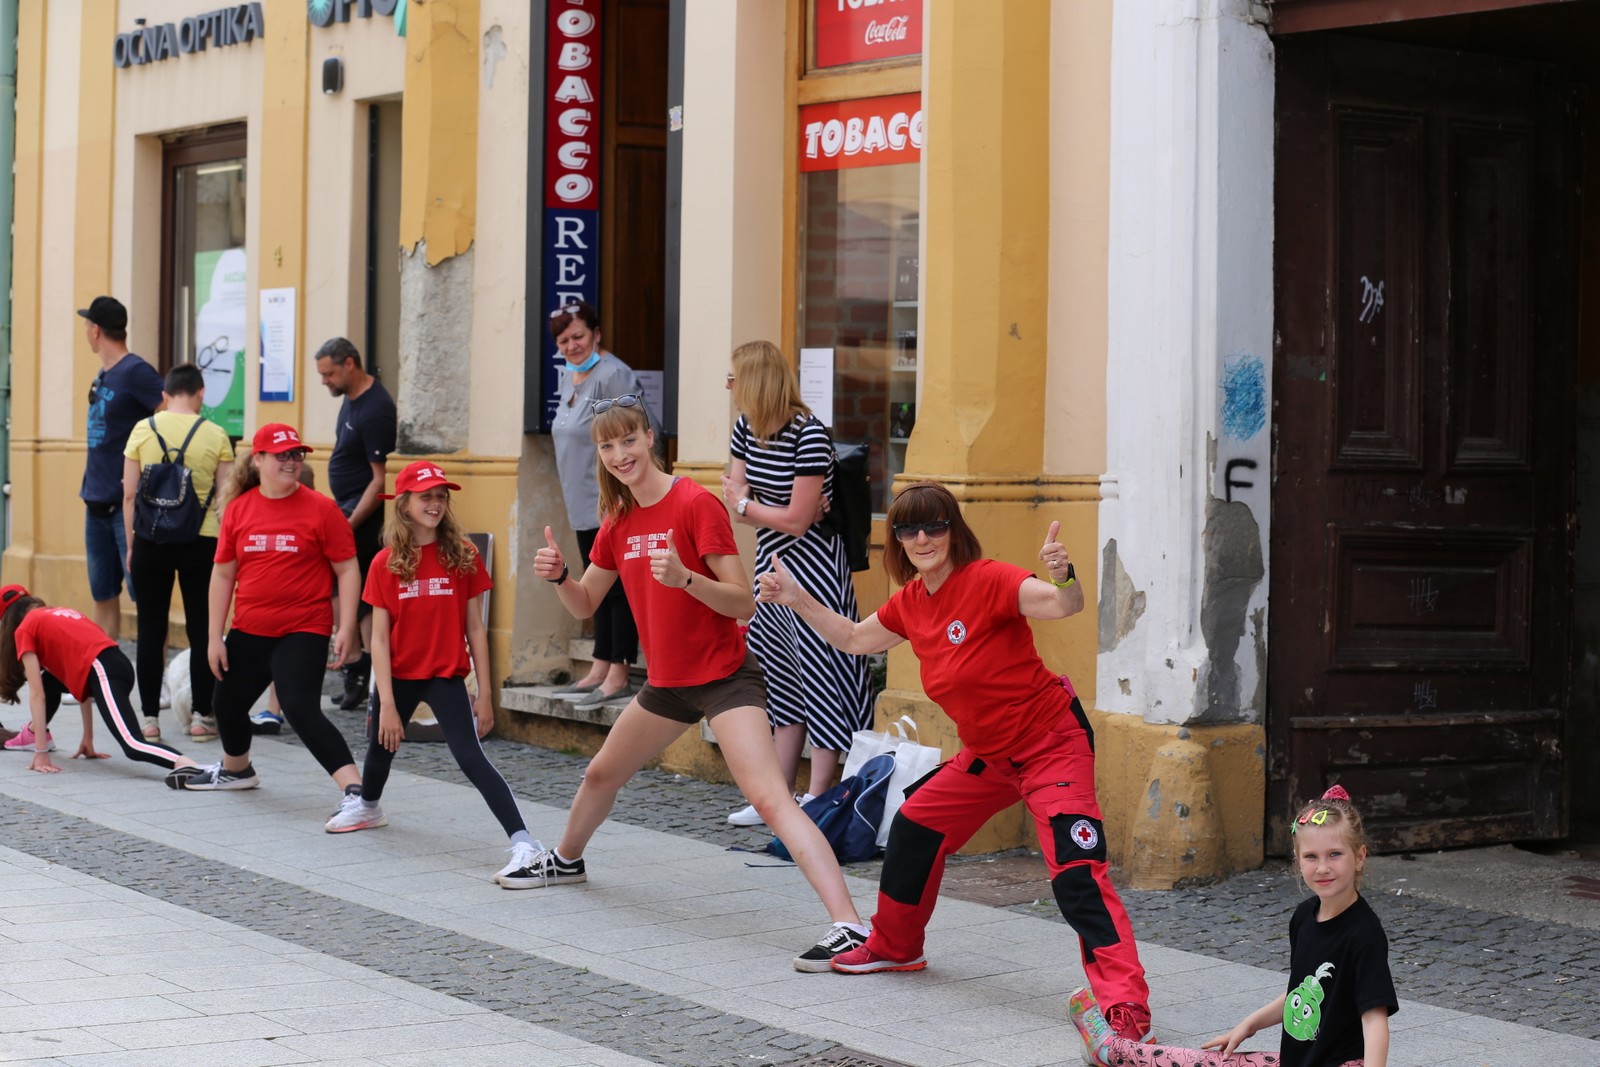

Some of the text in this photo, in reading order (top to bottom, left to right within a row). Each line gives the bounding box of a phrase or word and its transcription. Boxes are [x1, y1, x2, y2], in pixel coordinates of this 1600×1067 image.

[114, 18, 179, 68] OČNA
[180, 2, 264, 54] OPTIKA
[555, 0, 595, 202] OBACCO
[805, 110, 922, 159] TOBACC
